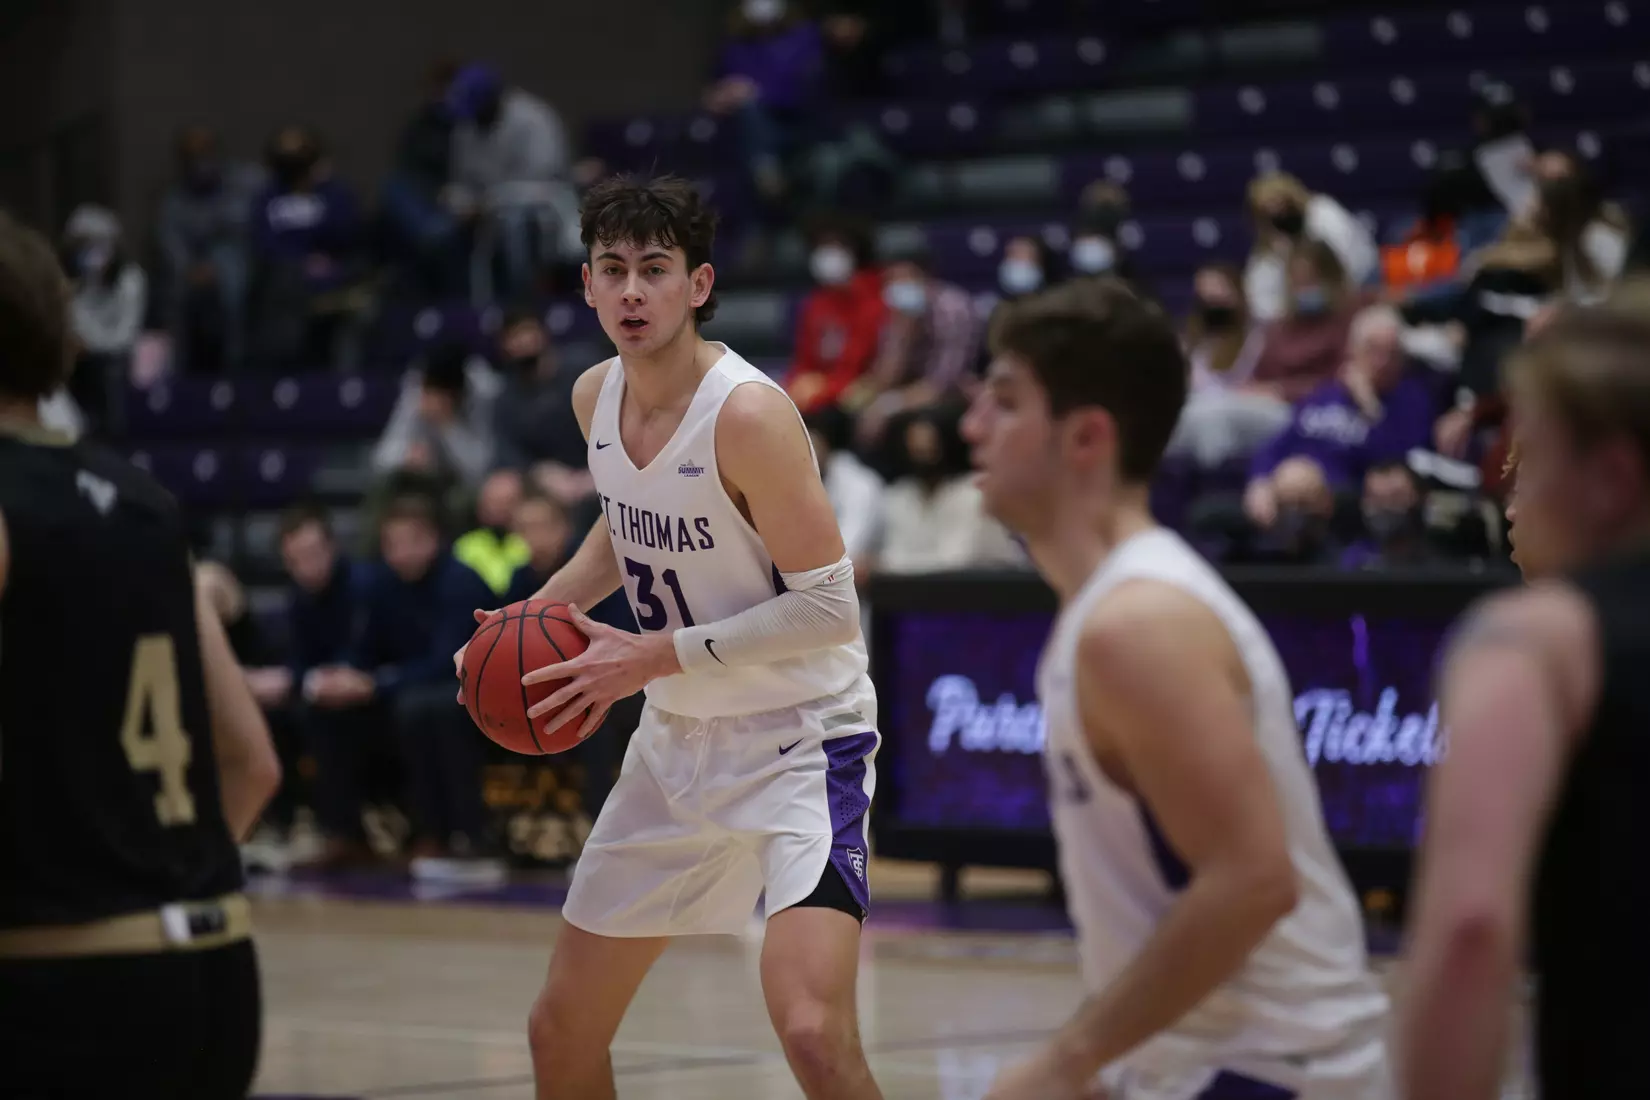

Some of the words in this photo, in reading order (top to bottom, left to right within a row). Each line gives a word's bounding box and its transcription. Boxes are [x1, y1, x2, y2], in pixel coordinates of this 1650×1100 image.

[678, 466, 704, 474] SUMMIT
[598, 492, 616, 536] T.
[617, 501, 715, 553] THOMAS
[624, 556, 696, 631] 31
[119, 633, 196, 826] 4
